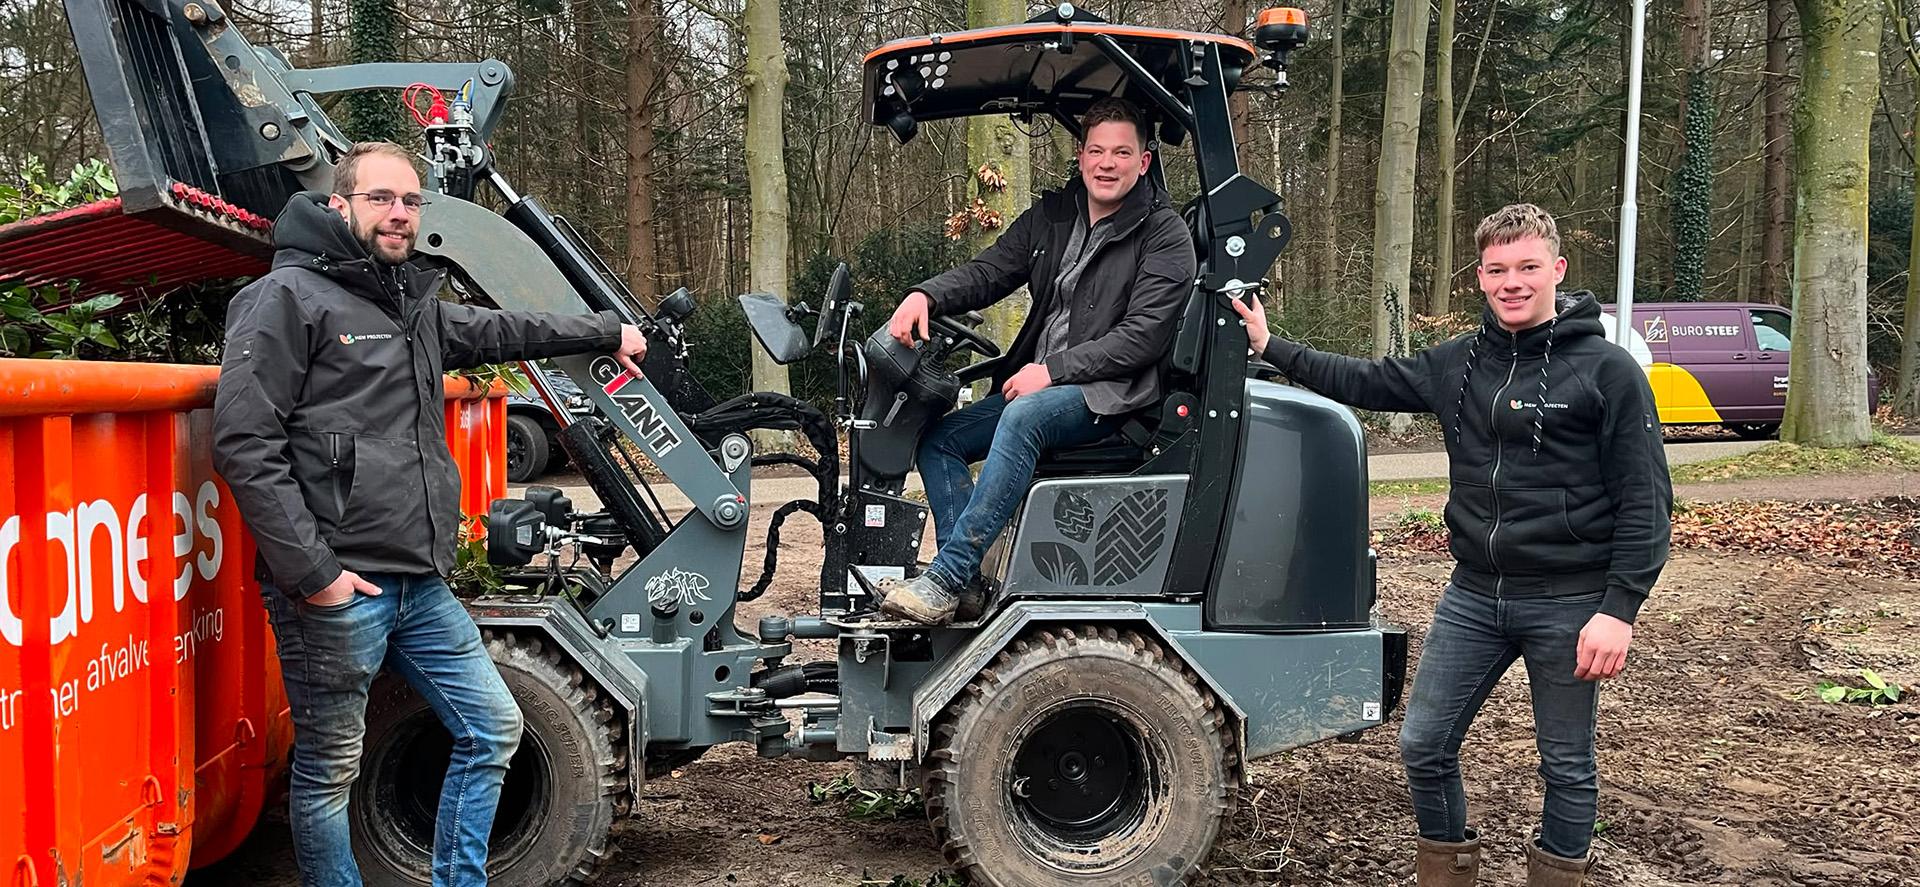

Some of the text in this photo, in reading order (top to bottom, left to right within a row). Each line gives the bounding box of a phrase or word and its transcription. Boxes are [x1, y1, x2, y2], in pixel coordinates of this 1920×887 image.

[1671, 325, 1739, 336] BURO STEEF
[589, 355, 682, 458] GIANT
[553, 721, 585, 778] SUPER
[1184, 736, 1207, 796] SUPER
